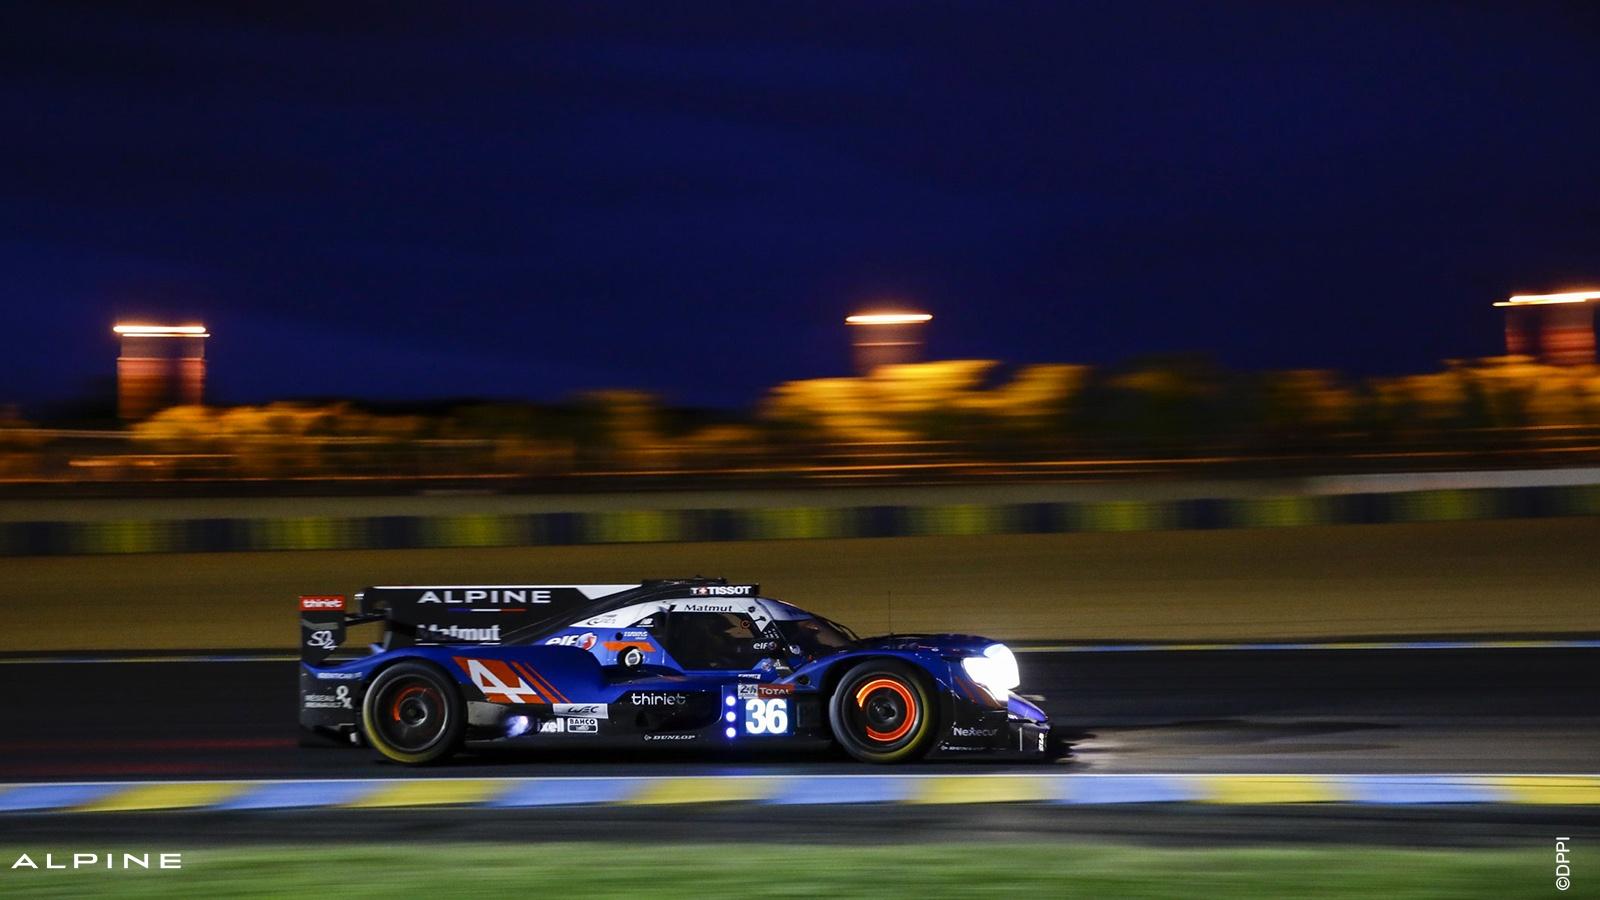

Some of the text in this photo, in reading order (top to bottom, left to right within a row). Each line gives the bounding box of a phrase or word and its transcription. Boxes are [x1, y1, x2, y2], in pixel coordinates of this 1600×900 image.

[417, 591, 551, 603] ALPINE
[685, 604, 733, 612] Matmut
[753, 642, 769, 650] elf
[759, 687, 791, 695] TOTAL
[631, 693, 686, 705] thiriet
[568, 705, 599, 714] WEC
[745, 698, 788, 734] 36
